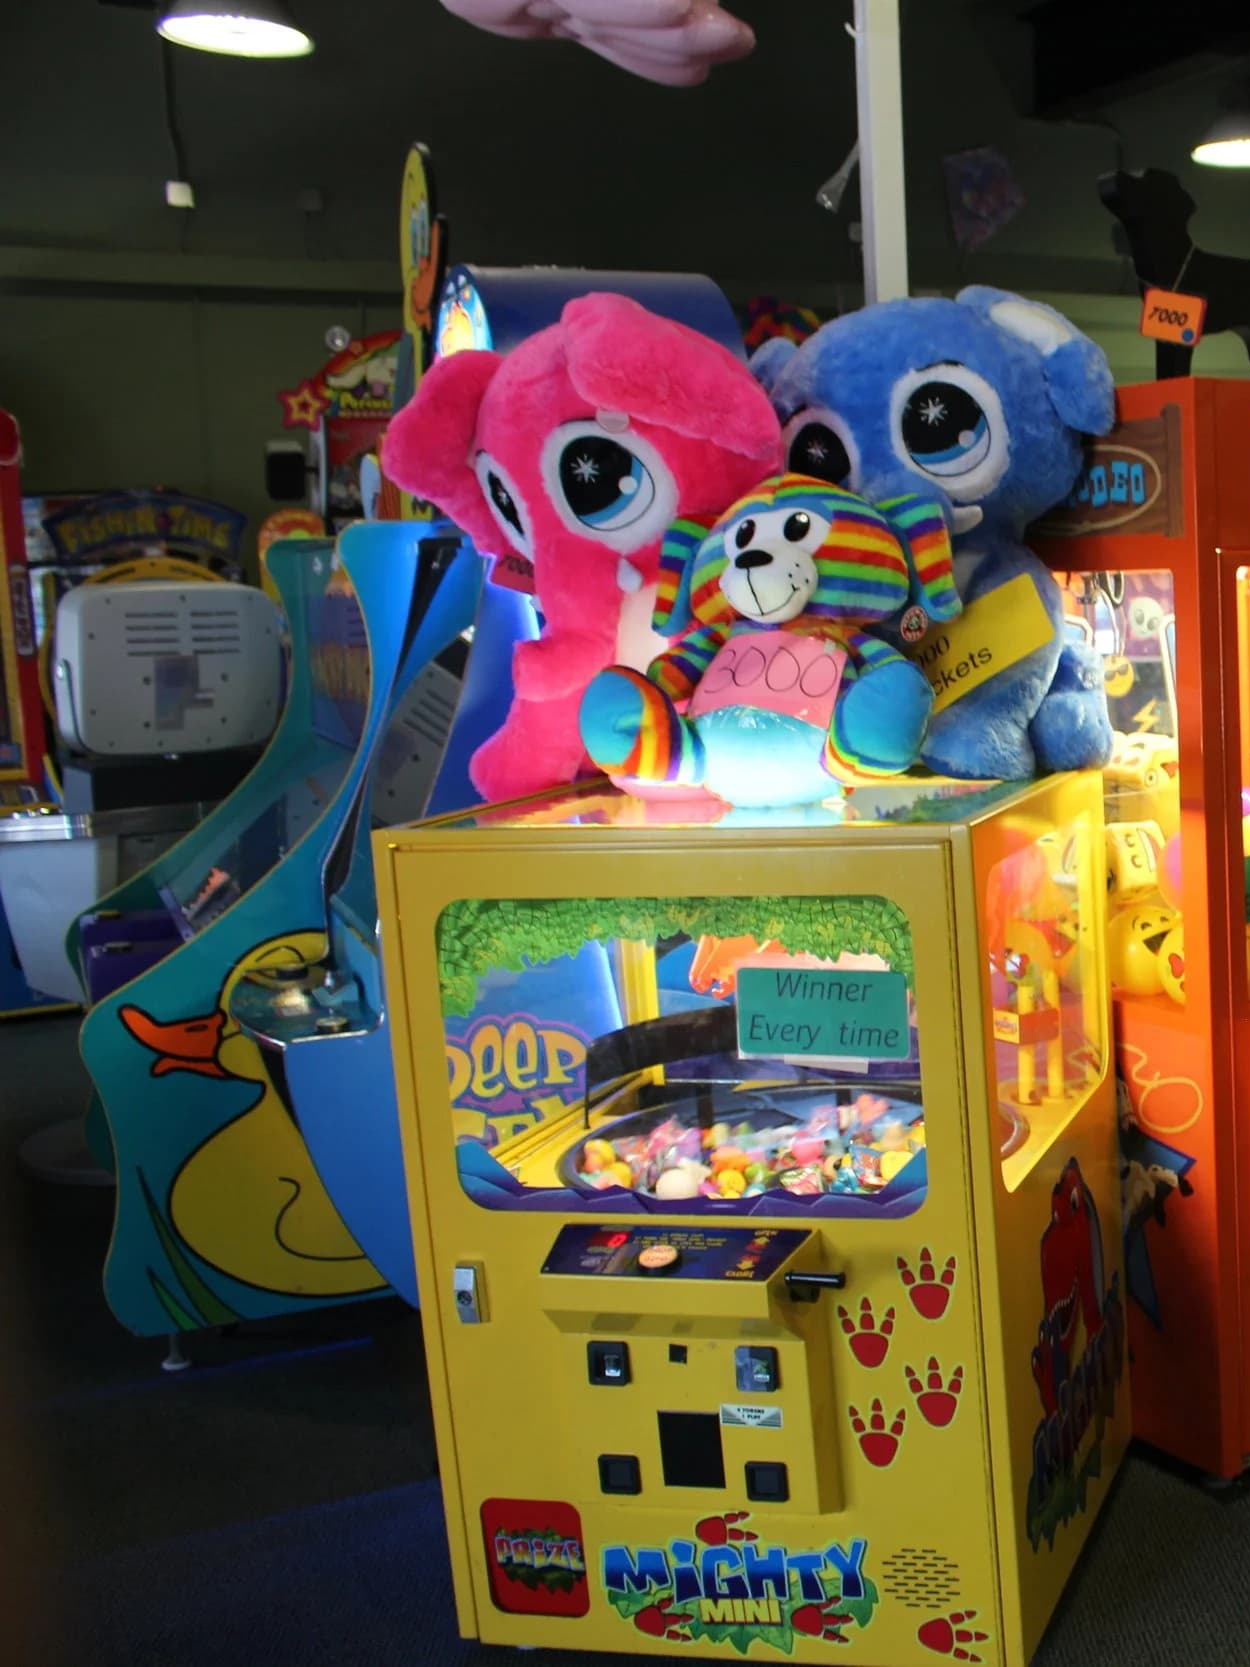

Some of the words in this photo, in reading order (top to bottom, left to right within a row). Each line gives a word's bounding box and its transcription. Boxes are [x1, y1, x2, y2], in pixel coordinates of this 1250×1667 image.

[1147, 305, 1189, 327] 7000
[933, 646, 994, 697] ckets
[775, 971, 874, 1003] Winner
[748, 1013, 821, 1051] Every
[838, 1017, 900, 1049] time
[700, 1598, 784, 1626] MINI
